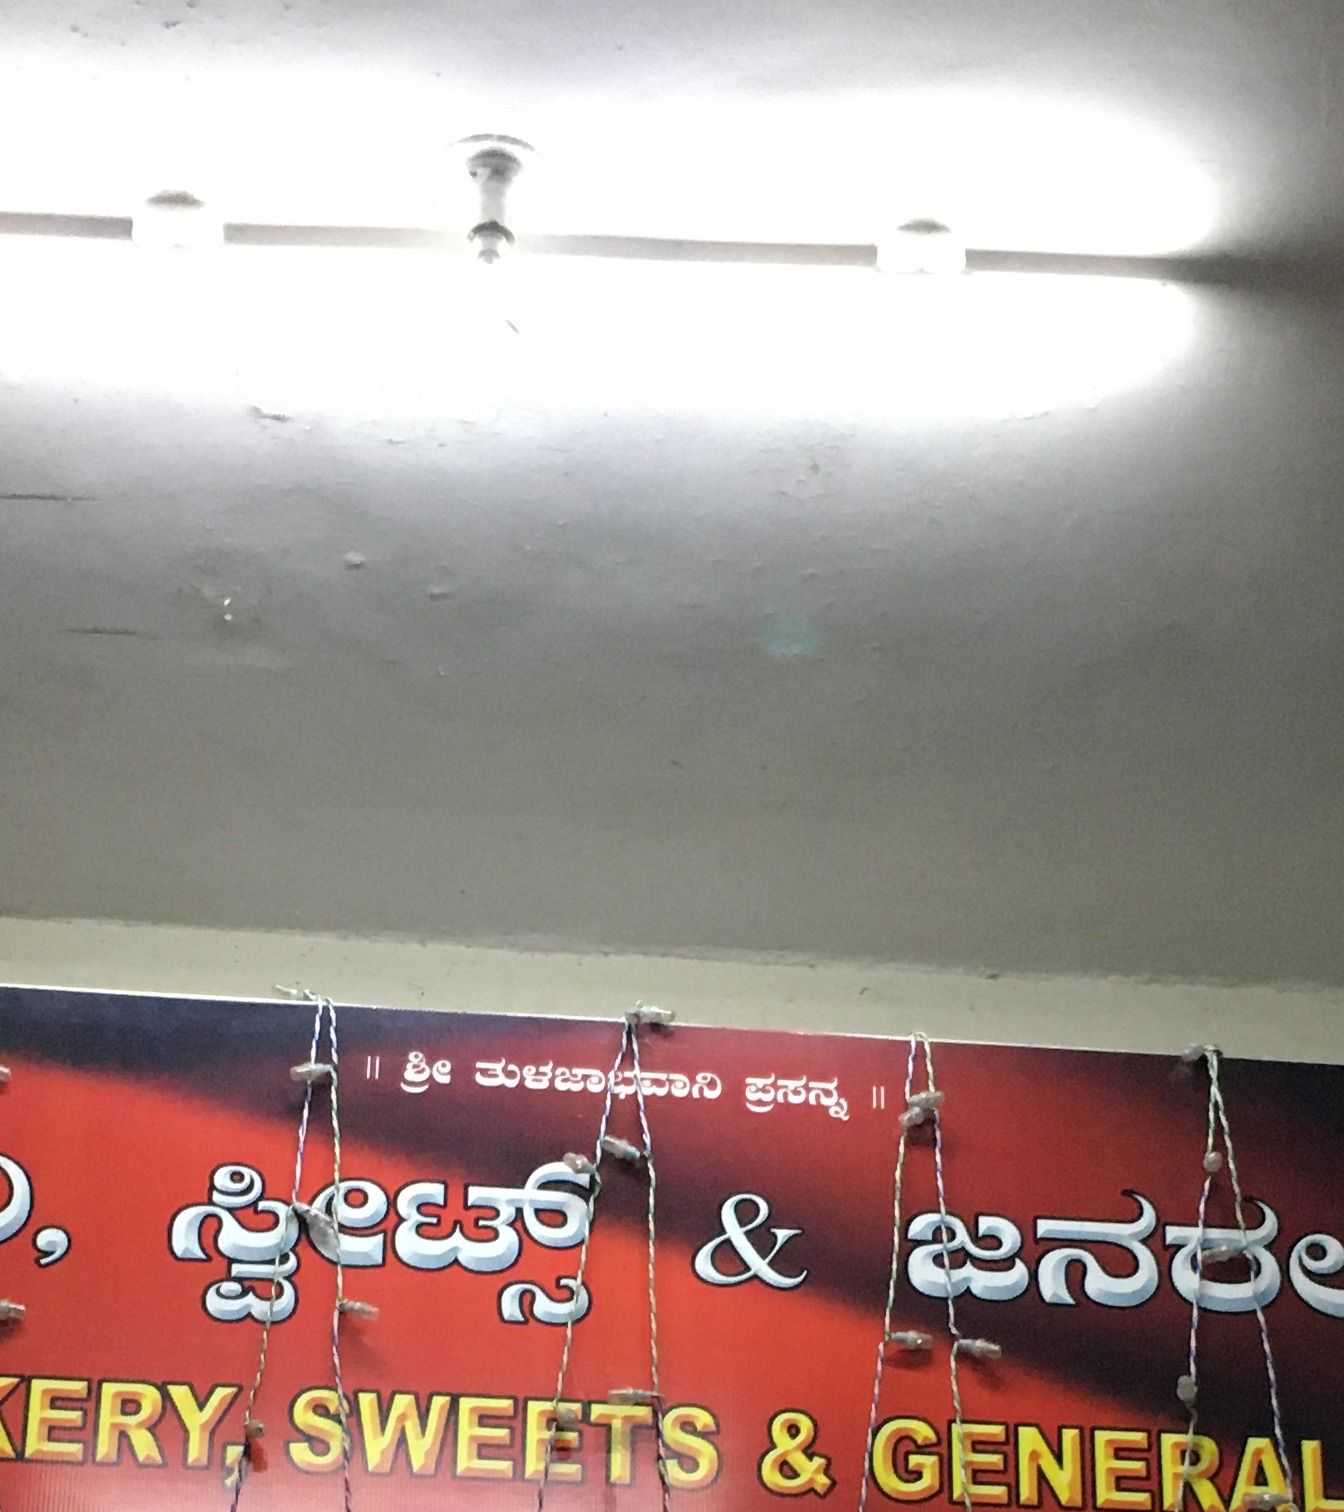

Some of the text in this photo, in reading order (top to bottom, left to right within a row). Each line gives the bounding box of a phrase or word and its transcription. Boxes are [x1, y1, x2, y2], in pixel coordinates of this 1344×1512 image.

[400, 1050, 452, 1095] ಶ್ರೀ
[692, 1191, 809, 1290] &
[287, 1386, 720, 1487] SWEETS
[762, 1411, 834, 1497] &
